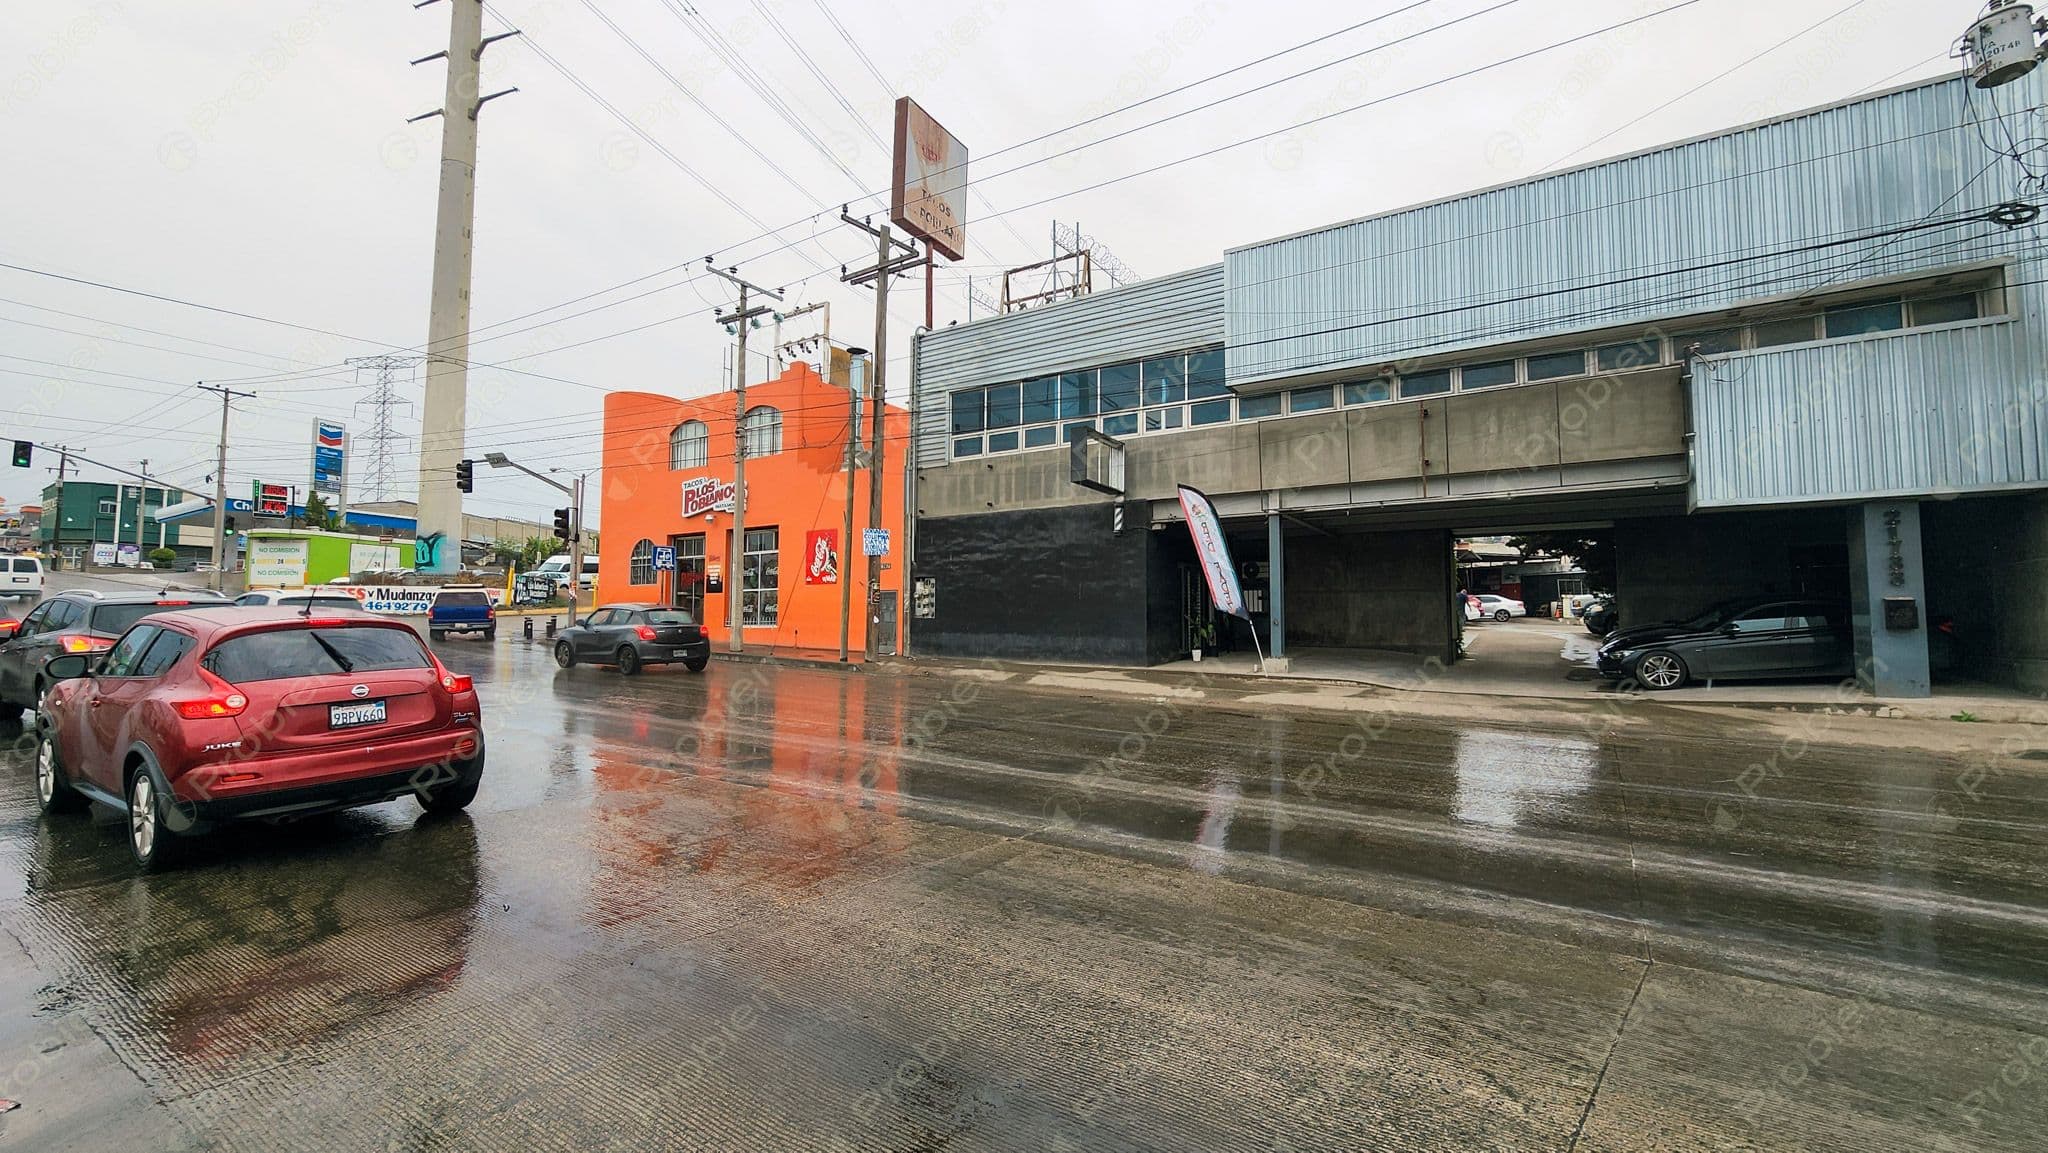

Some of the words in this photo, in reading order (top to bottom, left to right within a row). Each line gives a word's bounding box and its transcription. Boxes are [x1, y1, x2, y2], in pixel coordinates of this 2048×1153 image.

[684, 478, 703, 489] TACOS
[697, 481, 715, 498] LOS
[334, 708, 383, 725] 9BPV660
